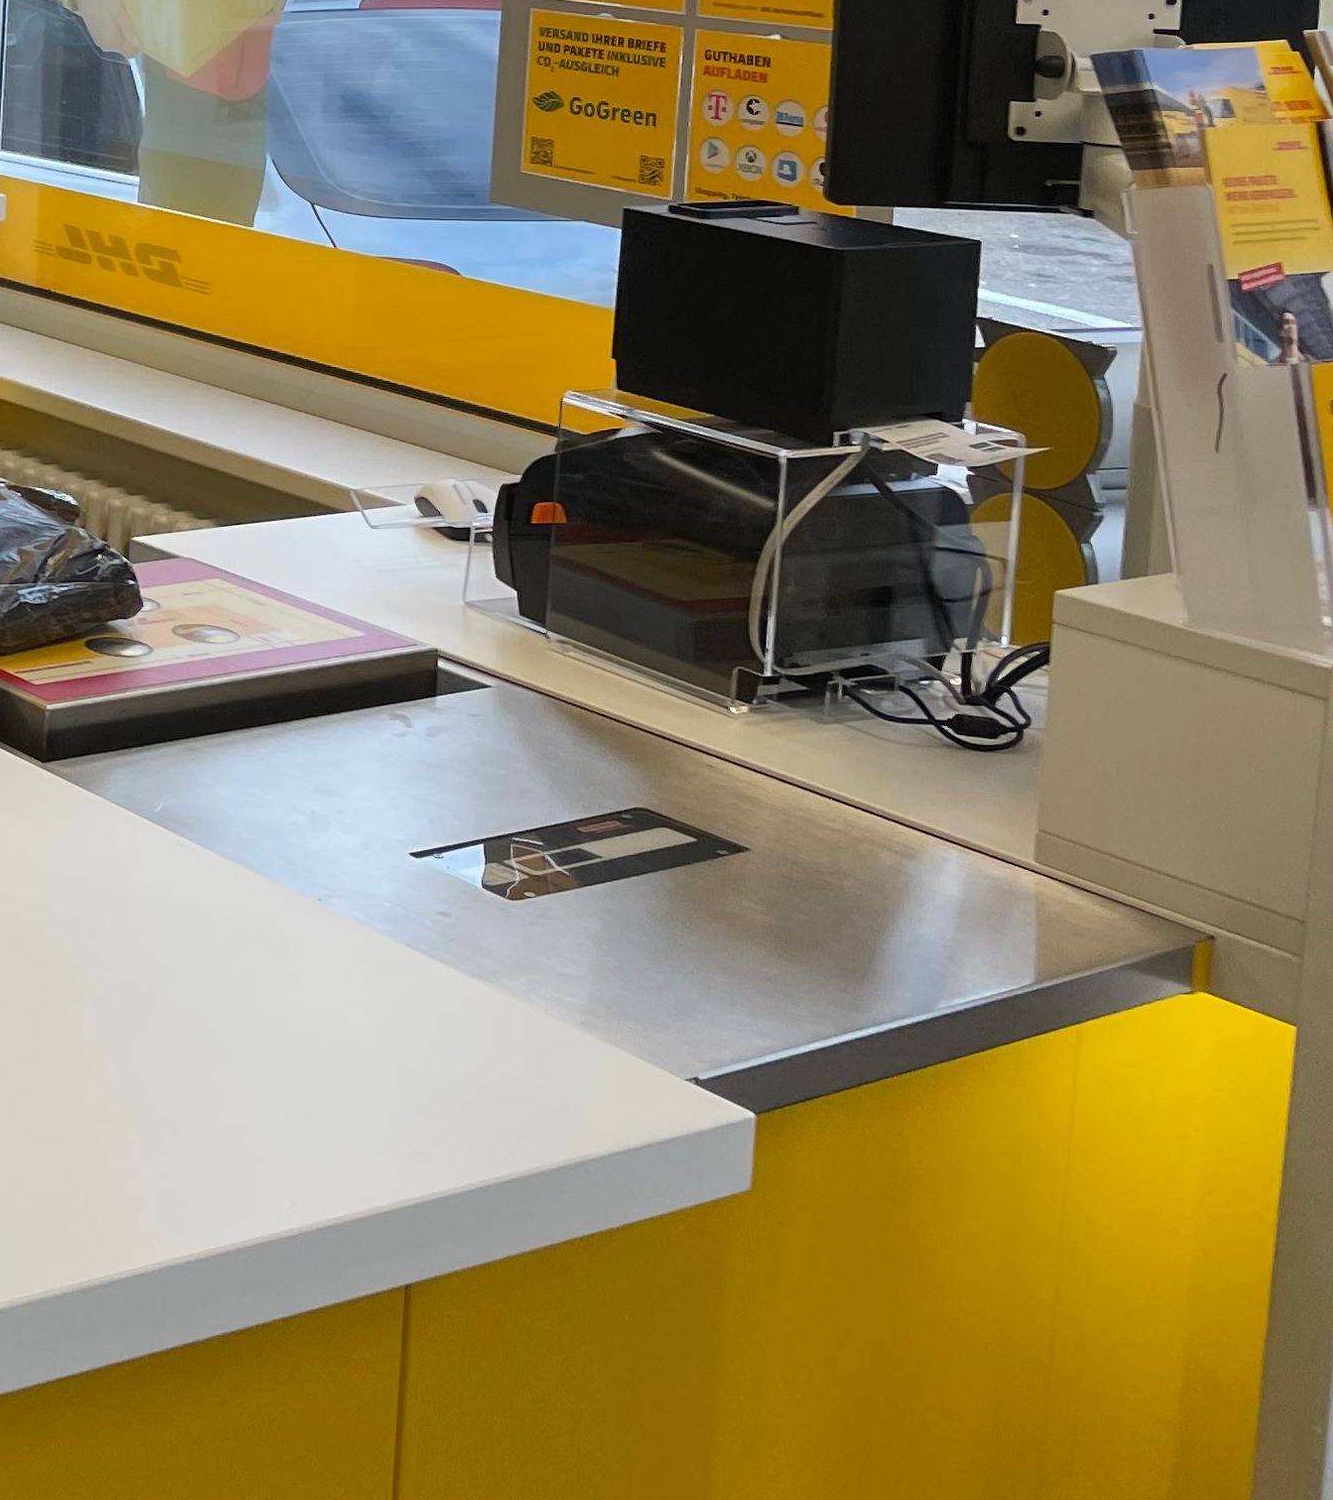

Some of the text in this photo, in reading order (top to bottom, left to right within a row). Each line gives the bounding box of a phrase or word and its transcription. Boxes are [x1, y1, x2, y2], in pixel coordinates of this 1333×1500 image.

[538, 26, 667, 53] VERSAND IHRER BRIEFE
[538, 41, 667, 68] UND PAKETE INKLUSIVE
[704, 49, 771, 68] GUTHABEN
[702, 66, 768, 84] AUFLADEN
[569, 97, 658, 128] GoGreen
